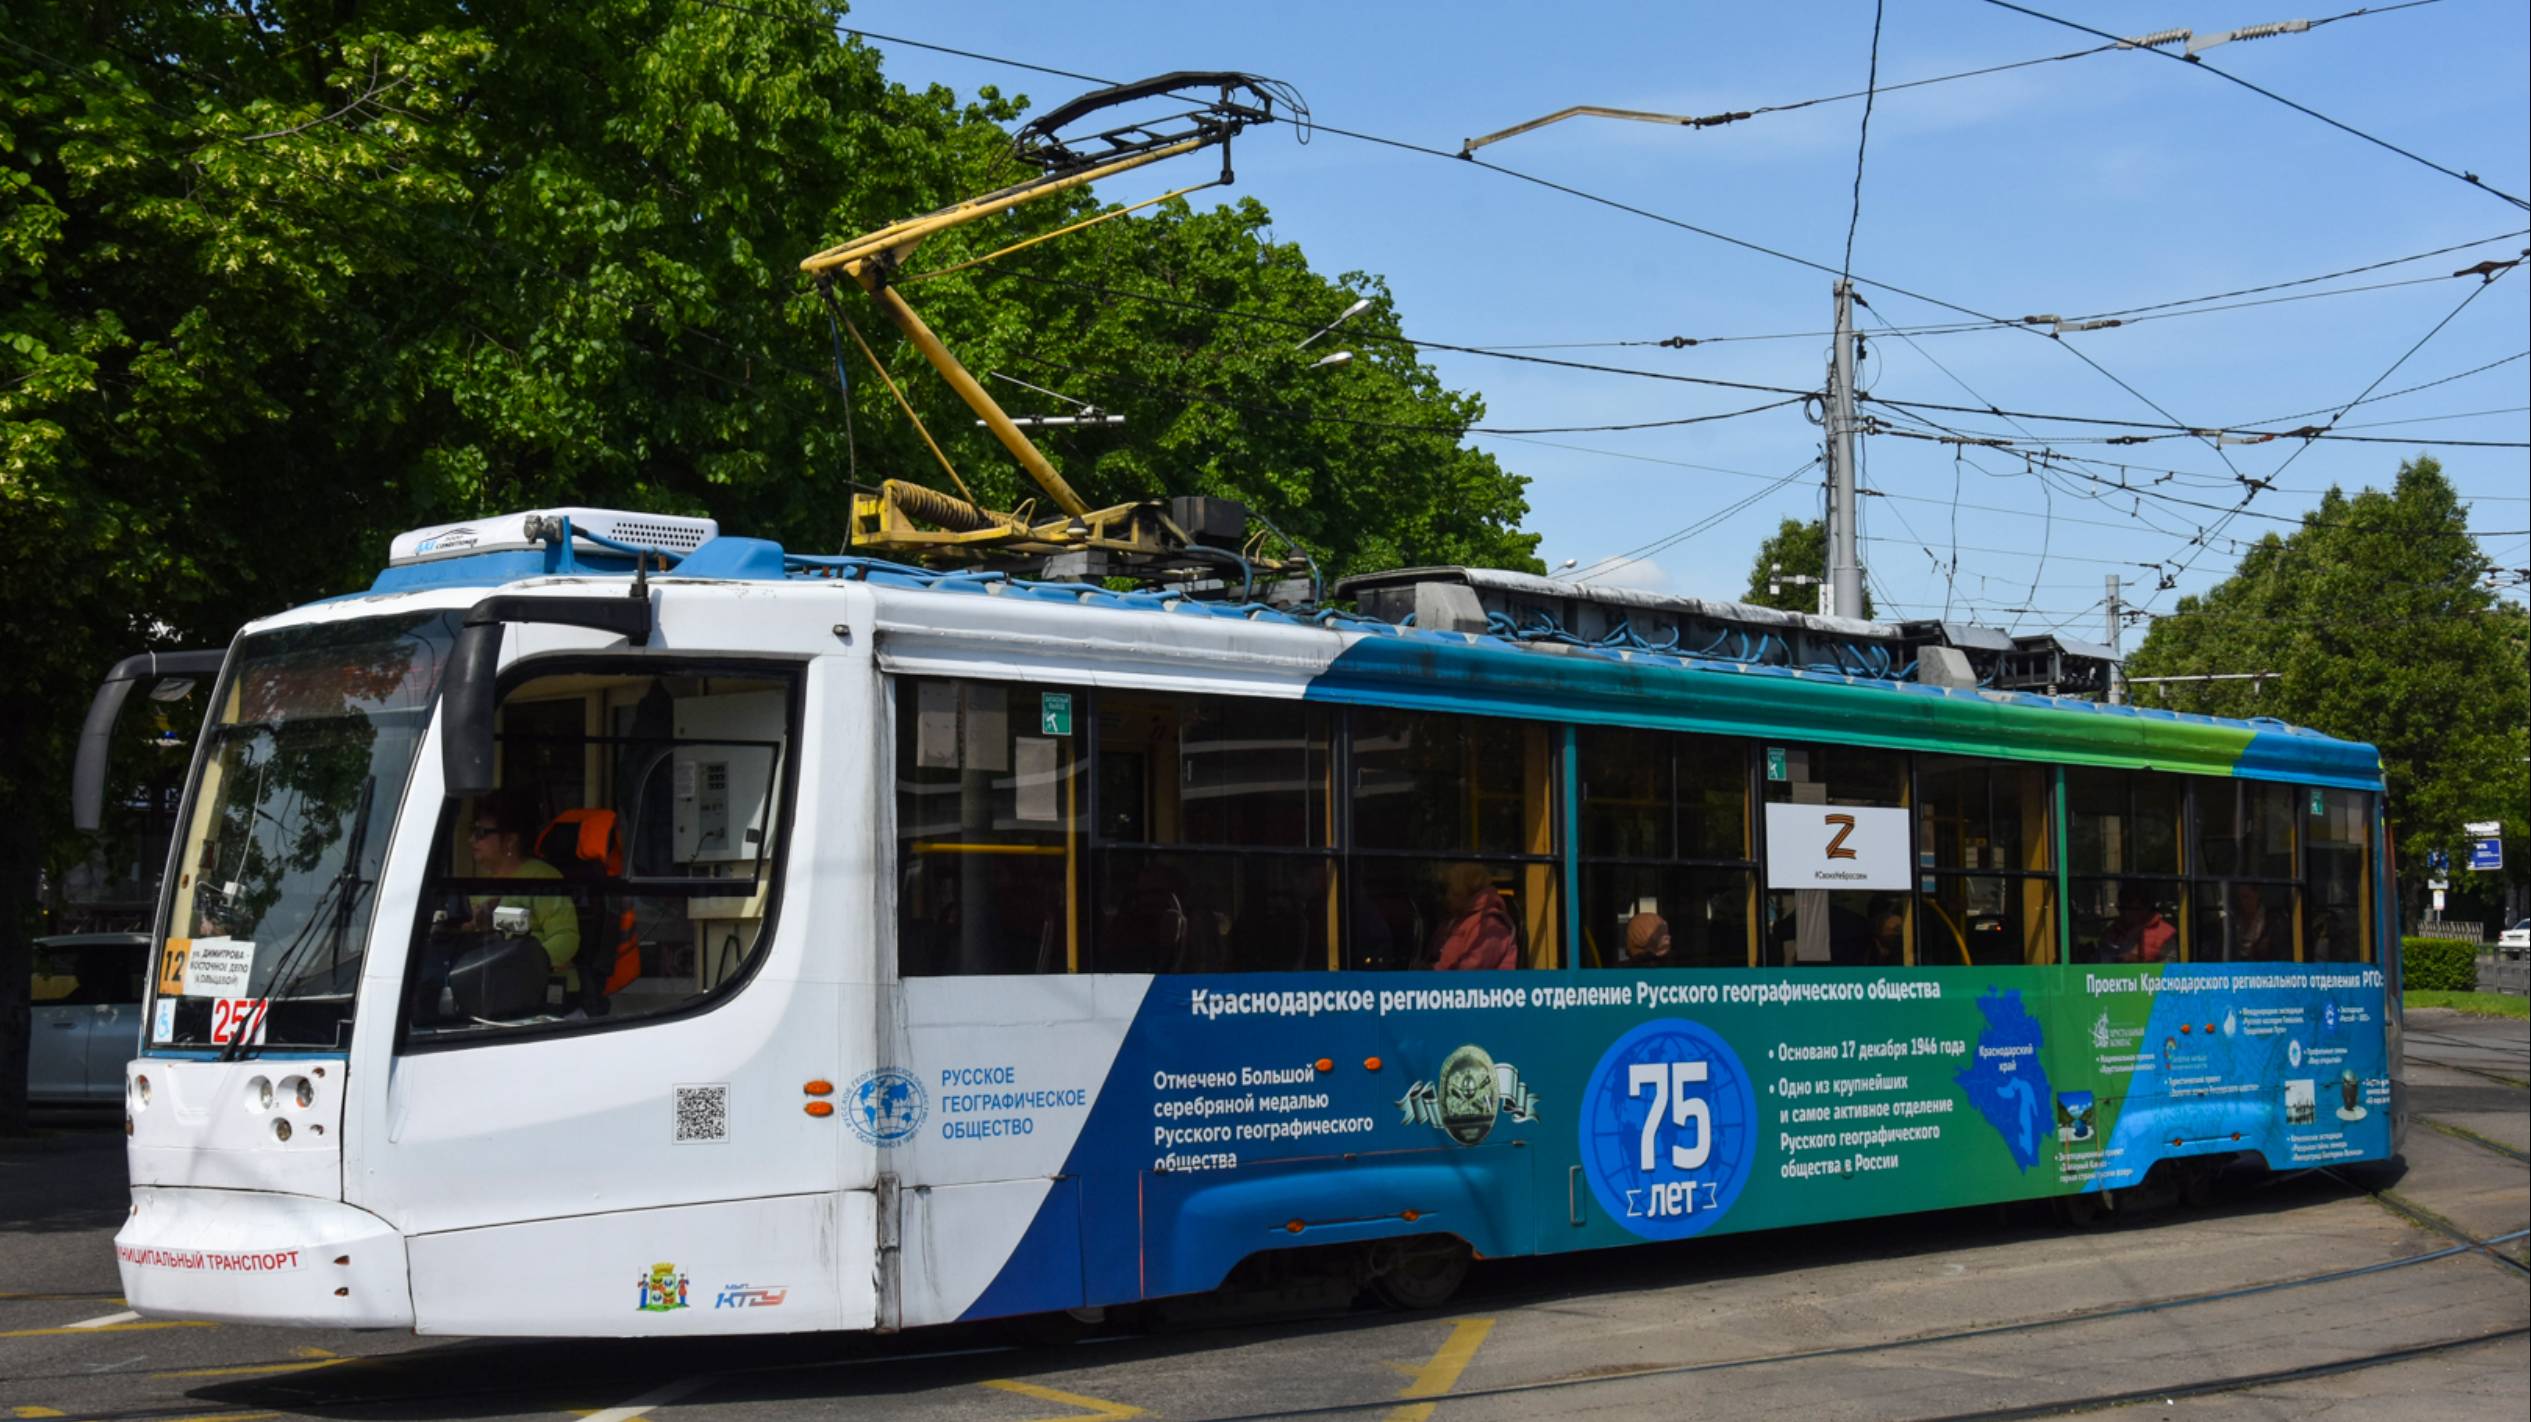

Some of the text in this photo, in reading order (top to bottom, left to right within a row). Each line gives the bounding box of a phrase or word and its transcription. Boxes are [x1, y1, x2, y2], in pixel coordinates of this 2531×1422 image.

[1825, 814, 1856, 859] Z
[164, 950, 185, 982] 12
[202, 948, 244, 960] ДИМИТРОВА
[190, 961, 248, 974] ВОСТОЧНОЕ ДЕПО
[2086, 970, 2384, 997] Проекты Краснодарского регионального отделения РГО:
[1191, 977, 1942, 1020] Краснодарское региональное отделение Русского географического общества
[213, 998, 268, 1043] 257
[1778, 1037, 1966, 1061] Основано 17 декабря 1946 года
[1979, 1042, 2034, 1058] Краснодарский
[941, 1066, 1015, 1087] РУССКОЕ
[1153, 1064, 1315, 1090] Отмечено Большой
[1999, 1060, 2017, 1074] край
[1778, 1073, 1908, 1099] Одно из крупнейших
[941, 1089, 1086, 1113] ГЕОГРАФИЧЕСКОЕ
[1153, 1092, 1330, 1119] серебряной медалью
[1780, 1098, 1953, 1123] и самое активное отделение
[942, 1117, 1034, 1140] ОБЩЕСТВО
[1629, 1061, 1712, 1171] 75
[1154, 1116, 1374, 1149] Русского географического
[1780, 1125, 1940, 1155] Русского географического
[1154, 1151, 1237, 1174] общества
[1781, 1153, 1899, 1179] общества в России
[1647, 1180, 1697, 1218] лет
[116, 1245, 299, 1271] УНИЦИПАЛЬНЫЙ ТРАНСПОРТ
